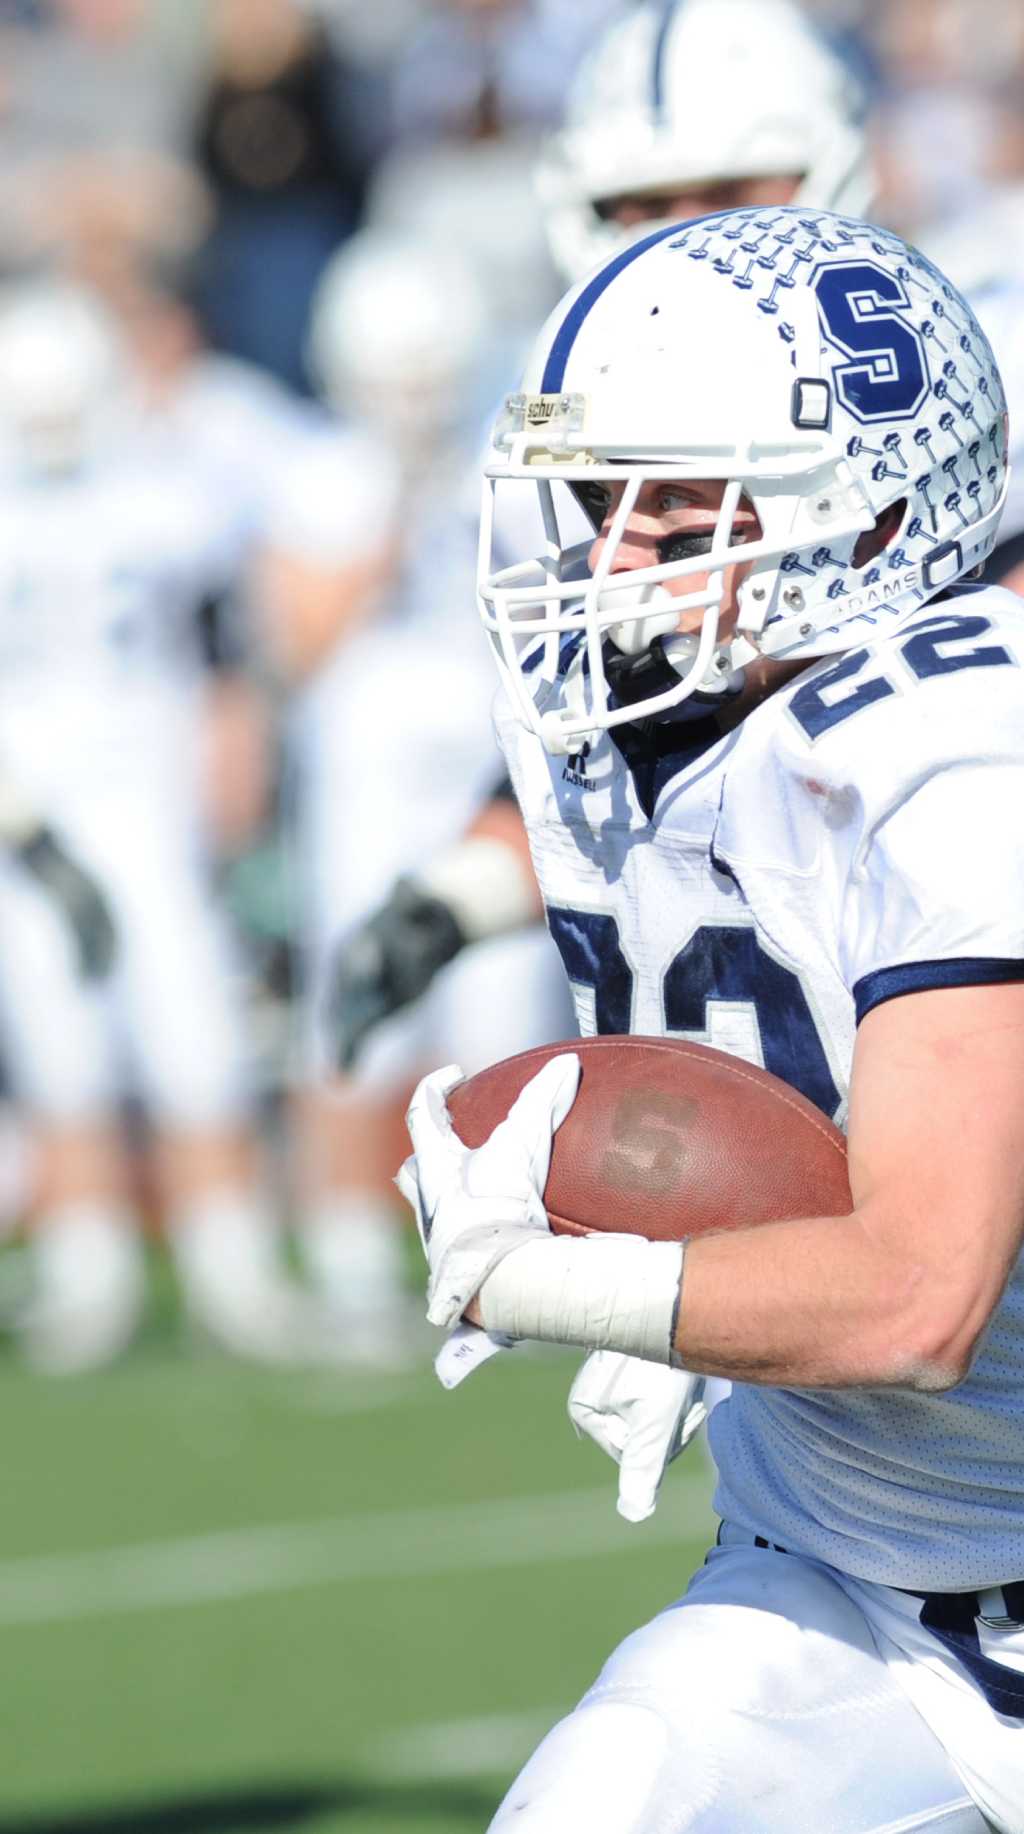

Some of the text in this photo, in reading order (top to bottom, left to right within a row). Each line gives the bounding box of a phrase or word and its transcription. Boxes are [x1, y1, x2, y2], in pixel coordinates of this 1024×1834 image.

[527, 397, 564, 418] schu
[808, 259, 933, 426] S
[786, 614, 1015, 744] 22
